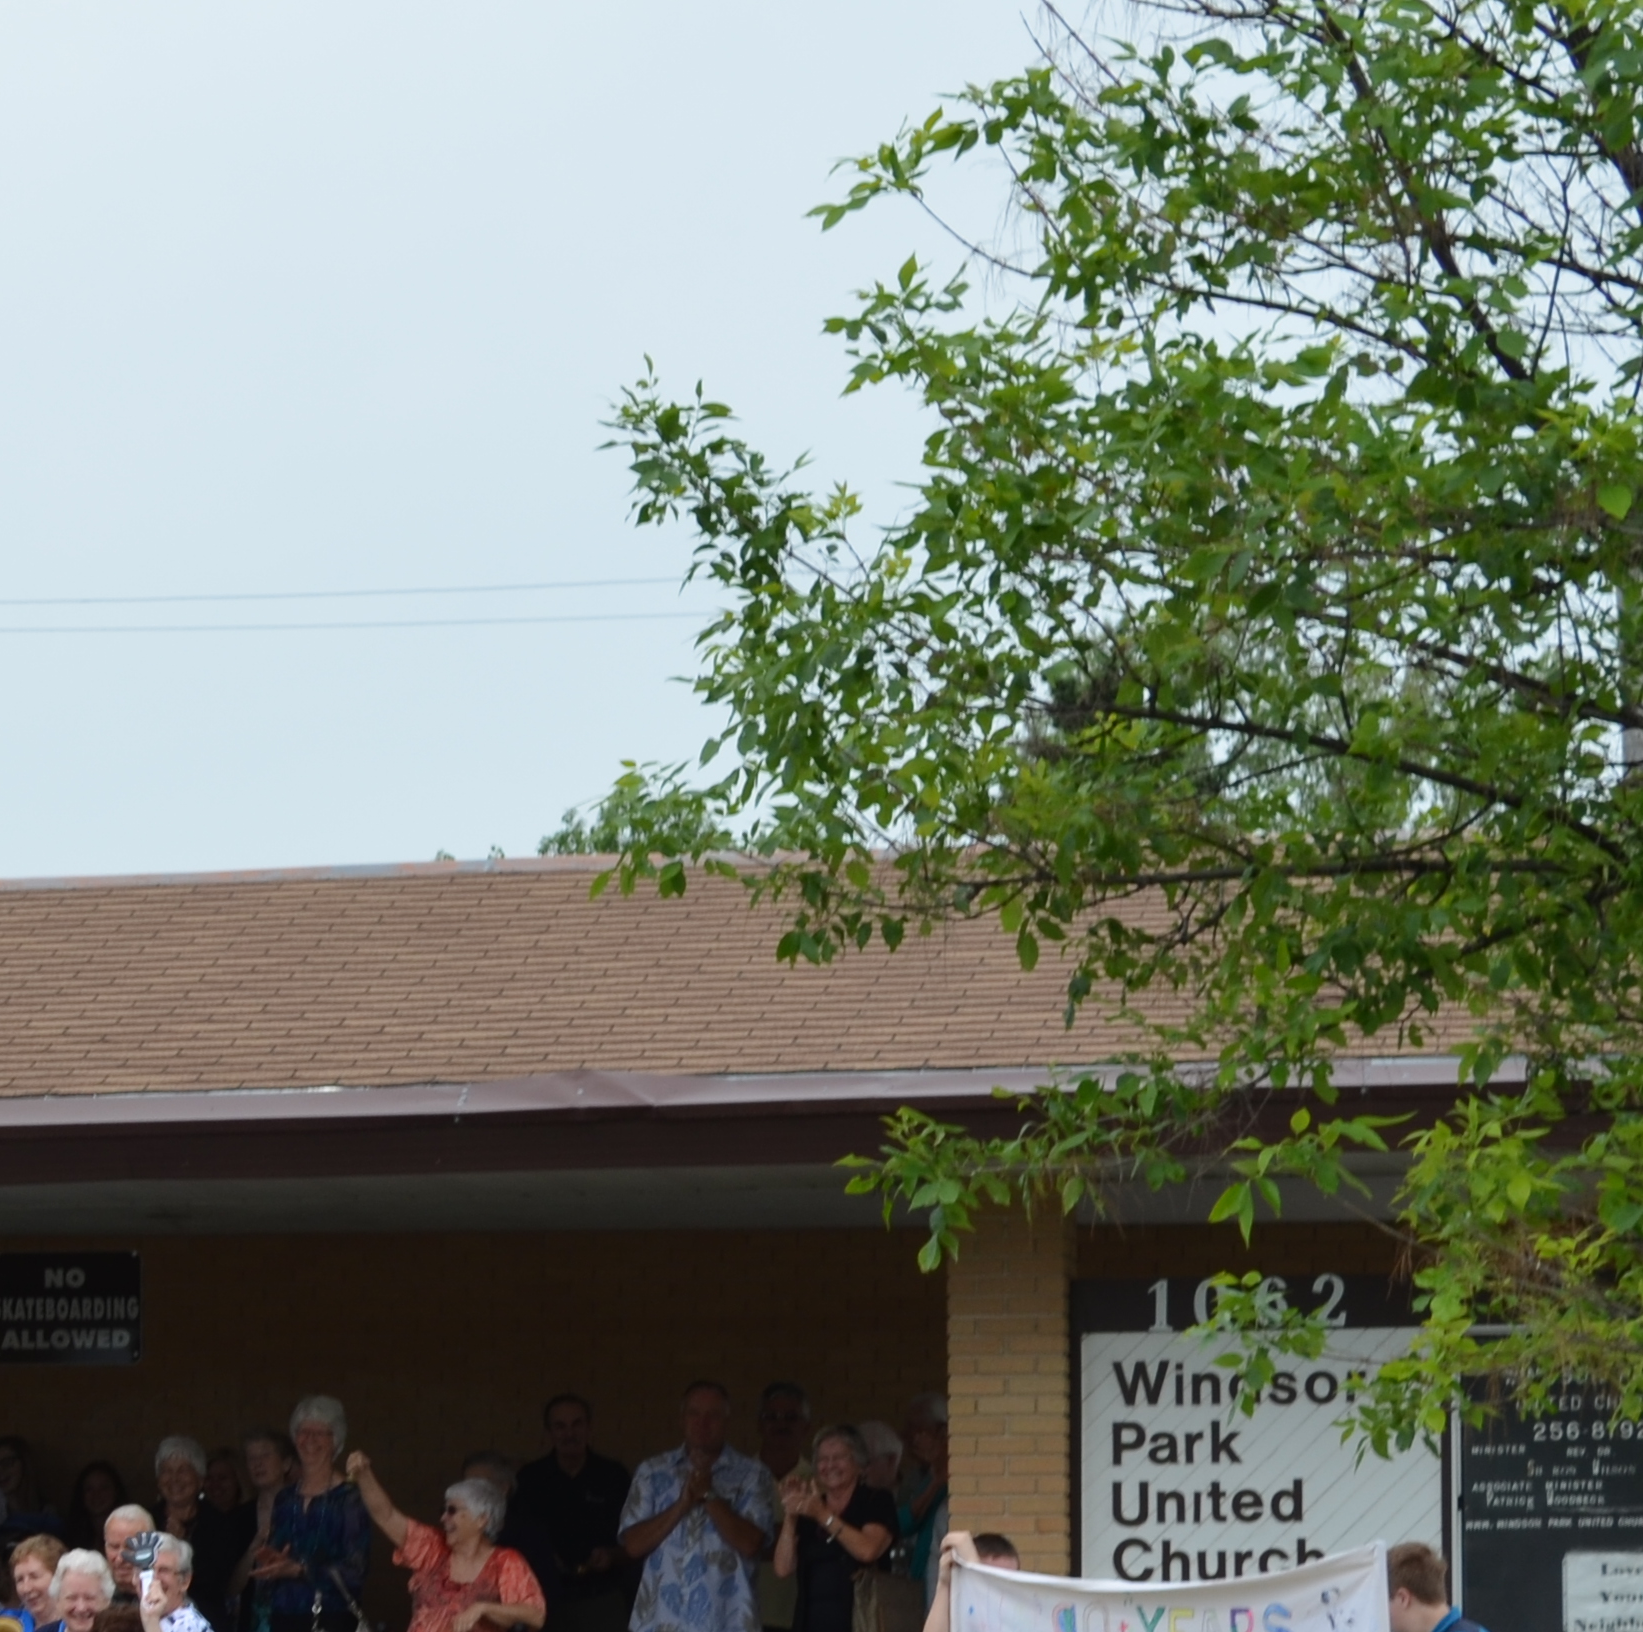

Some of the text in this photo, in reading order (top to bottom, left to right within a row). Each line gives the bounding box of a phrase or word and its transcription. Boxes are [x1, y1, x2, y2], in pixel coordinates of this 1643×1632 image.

[44, 1267, 86, 1289] NO
[1, 1328, 131, 1350] ALLOWED
[1113, 1421, 1242, 1466] Park
[1113, 1478, 1303, 1527] United
[1113, 1537, 1326, 1583] Church
